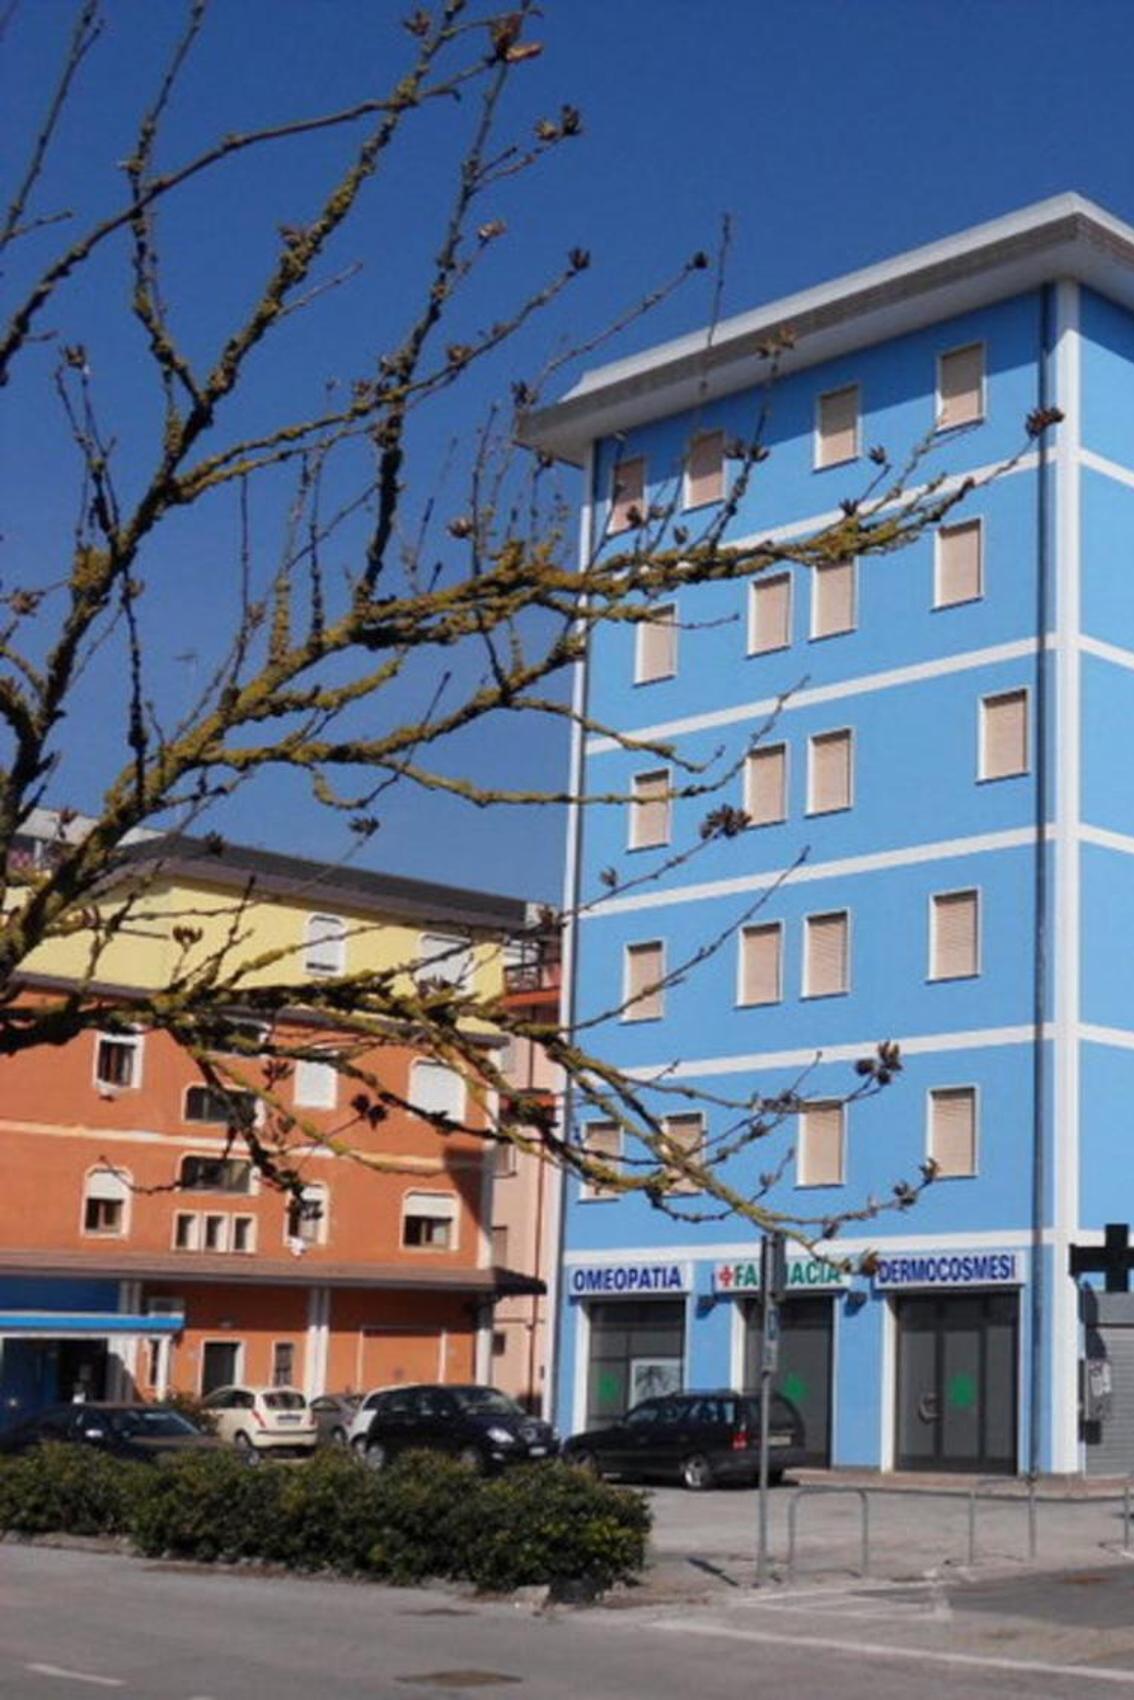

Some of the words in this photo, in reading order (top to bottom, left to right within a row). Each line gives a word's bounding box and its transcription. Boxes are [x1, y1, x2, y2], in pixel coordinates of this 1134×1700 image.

[574, 1267, 681, 1291] OMEOPATIA
[734, 1262, 842, 1286] FAACIA
[879, 1255, 1016, 1283] DERMOCOSMESI
